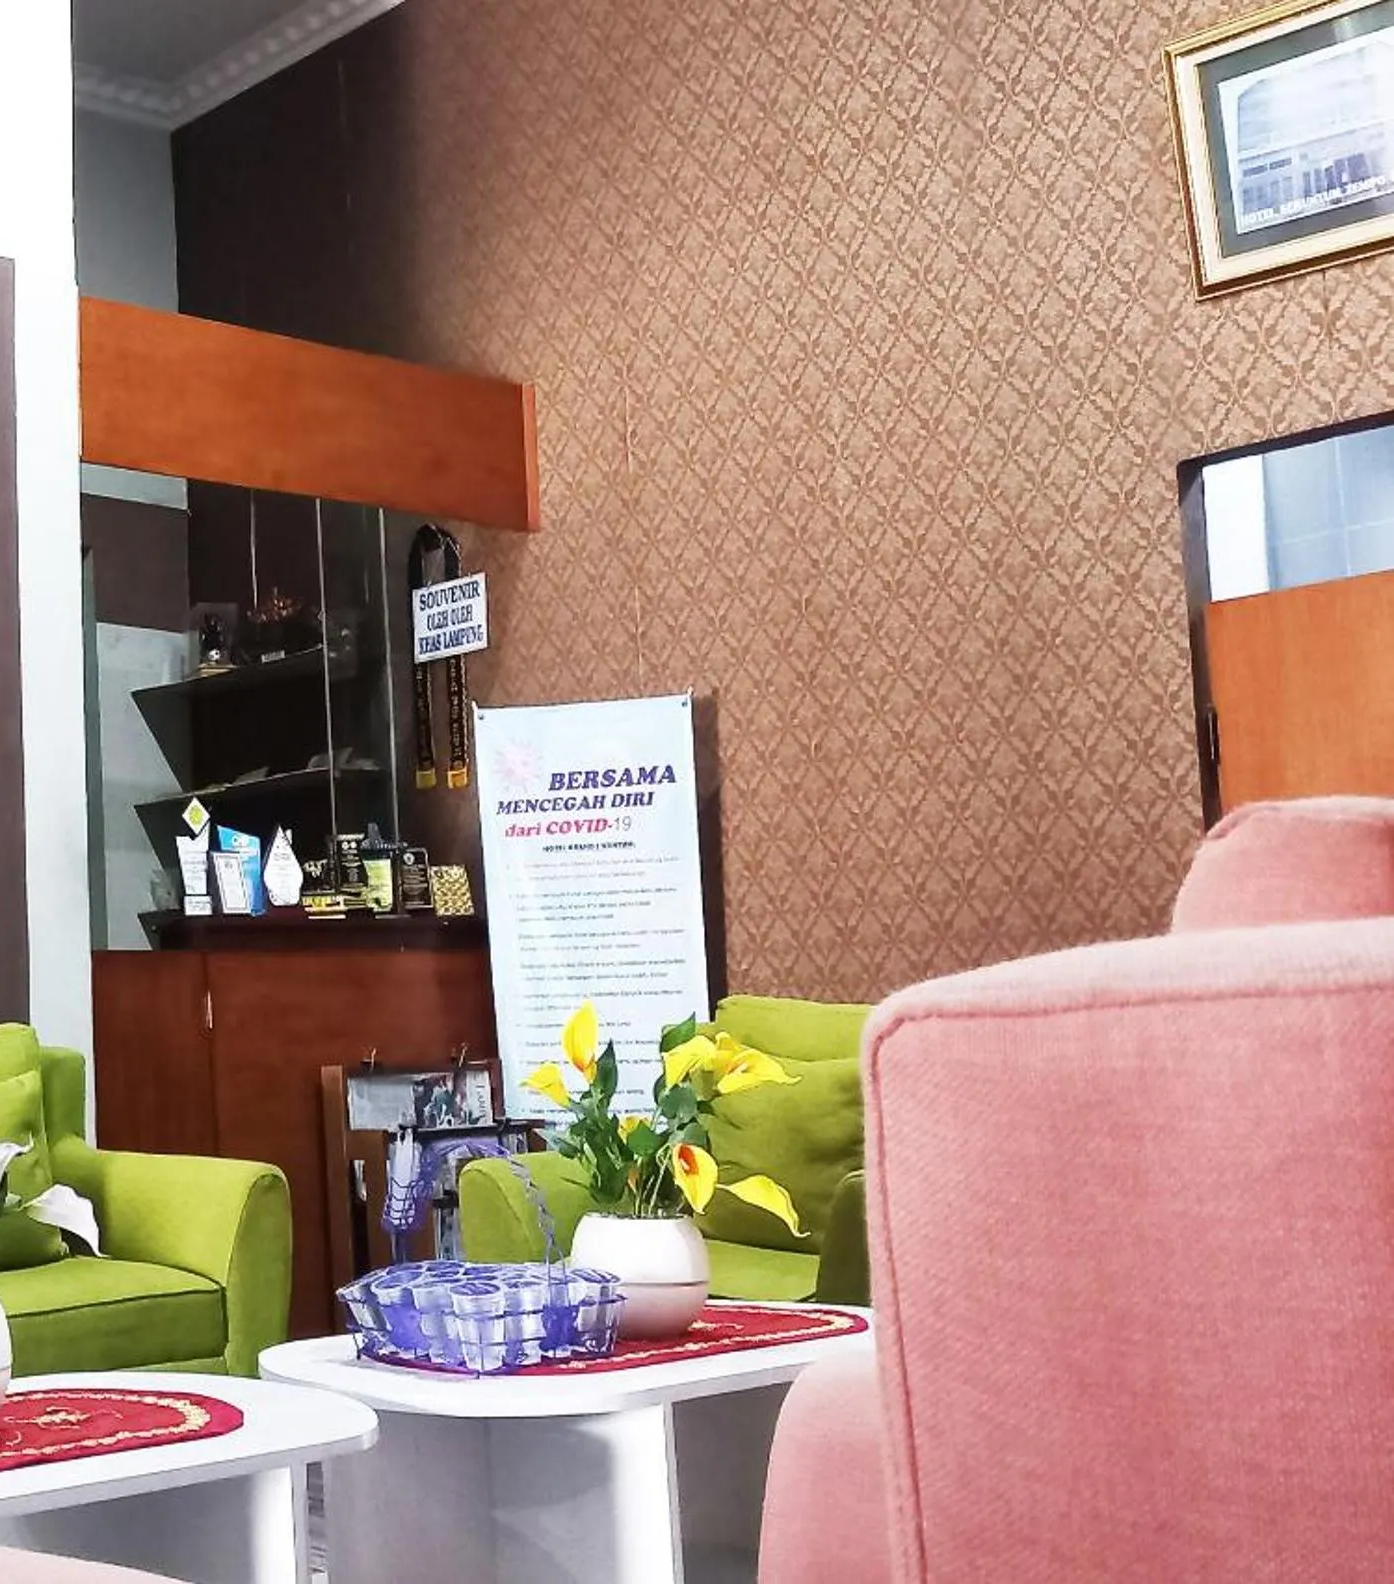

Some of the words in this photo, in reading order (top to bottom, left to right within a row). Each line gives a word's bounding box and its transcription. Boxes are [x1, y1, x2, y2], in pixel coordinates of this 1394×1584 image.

[419, 580, 480, 611] SOUVENIR
[548, 764, 677, 791] BERSAMA
[496, 794, 606, 815] MENCEGAH
[611, 791, 655, 808] DIRI
[505, 822, 542, 838] dari
[546, 815, 632, 835] COVID-19
